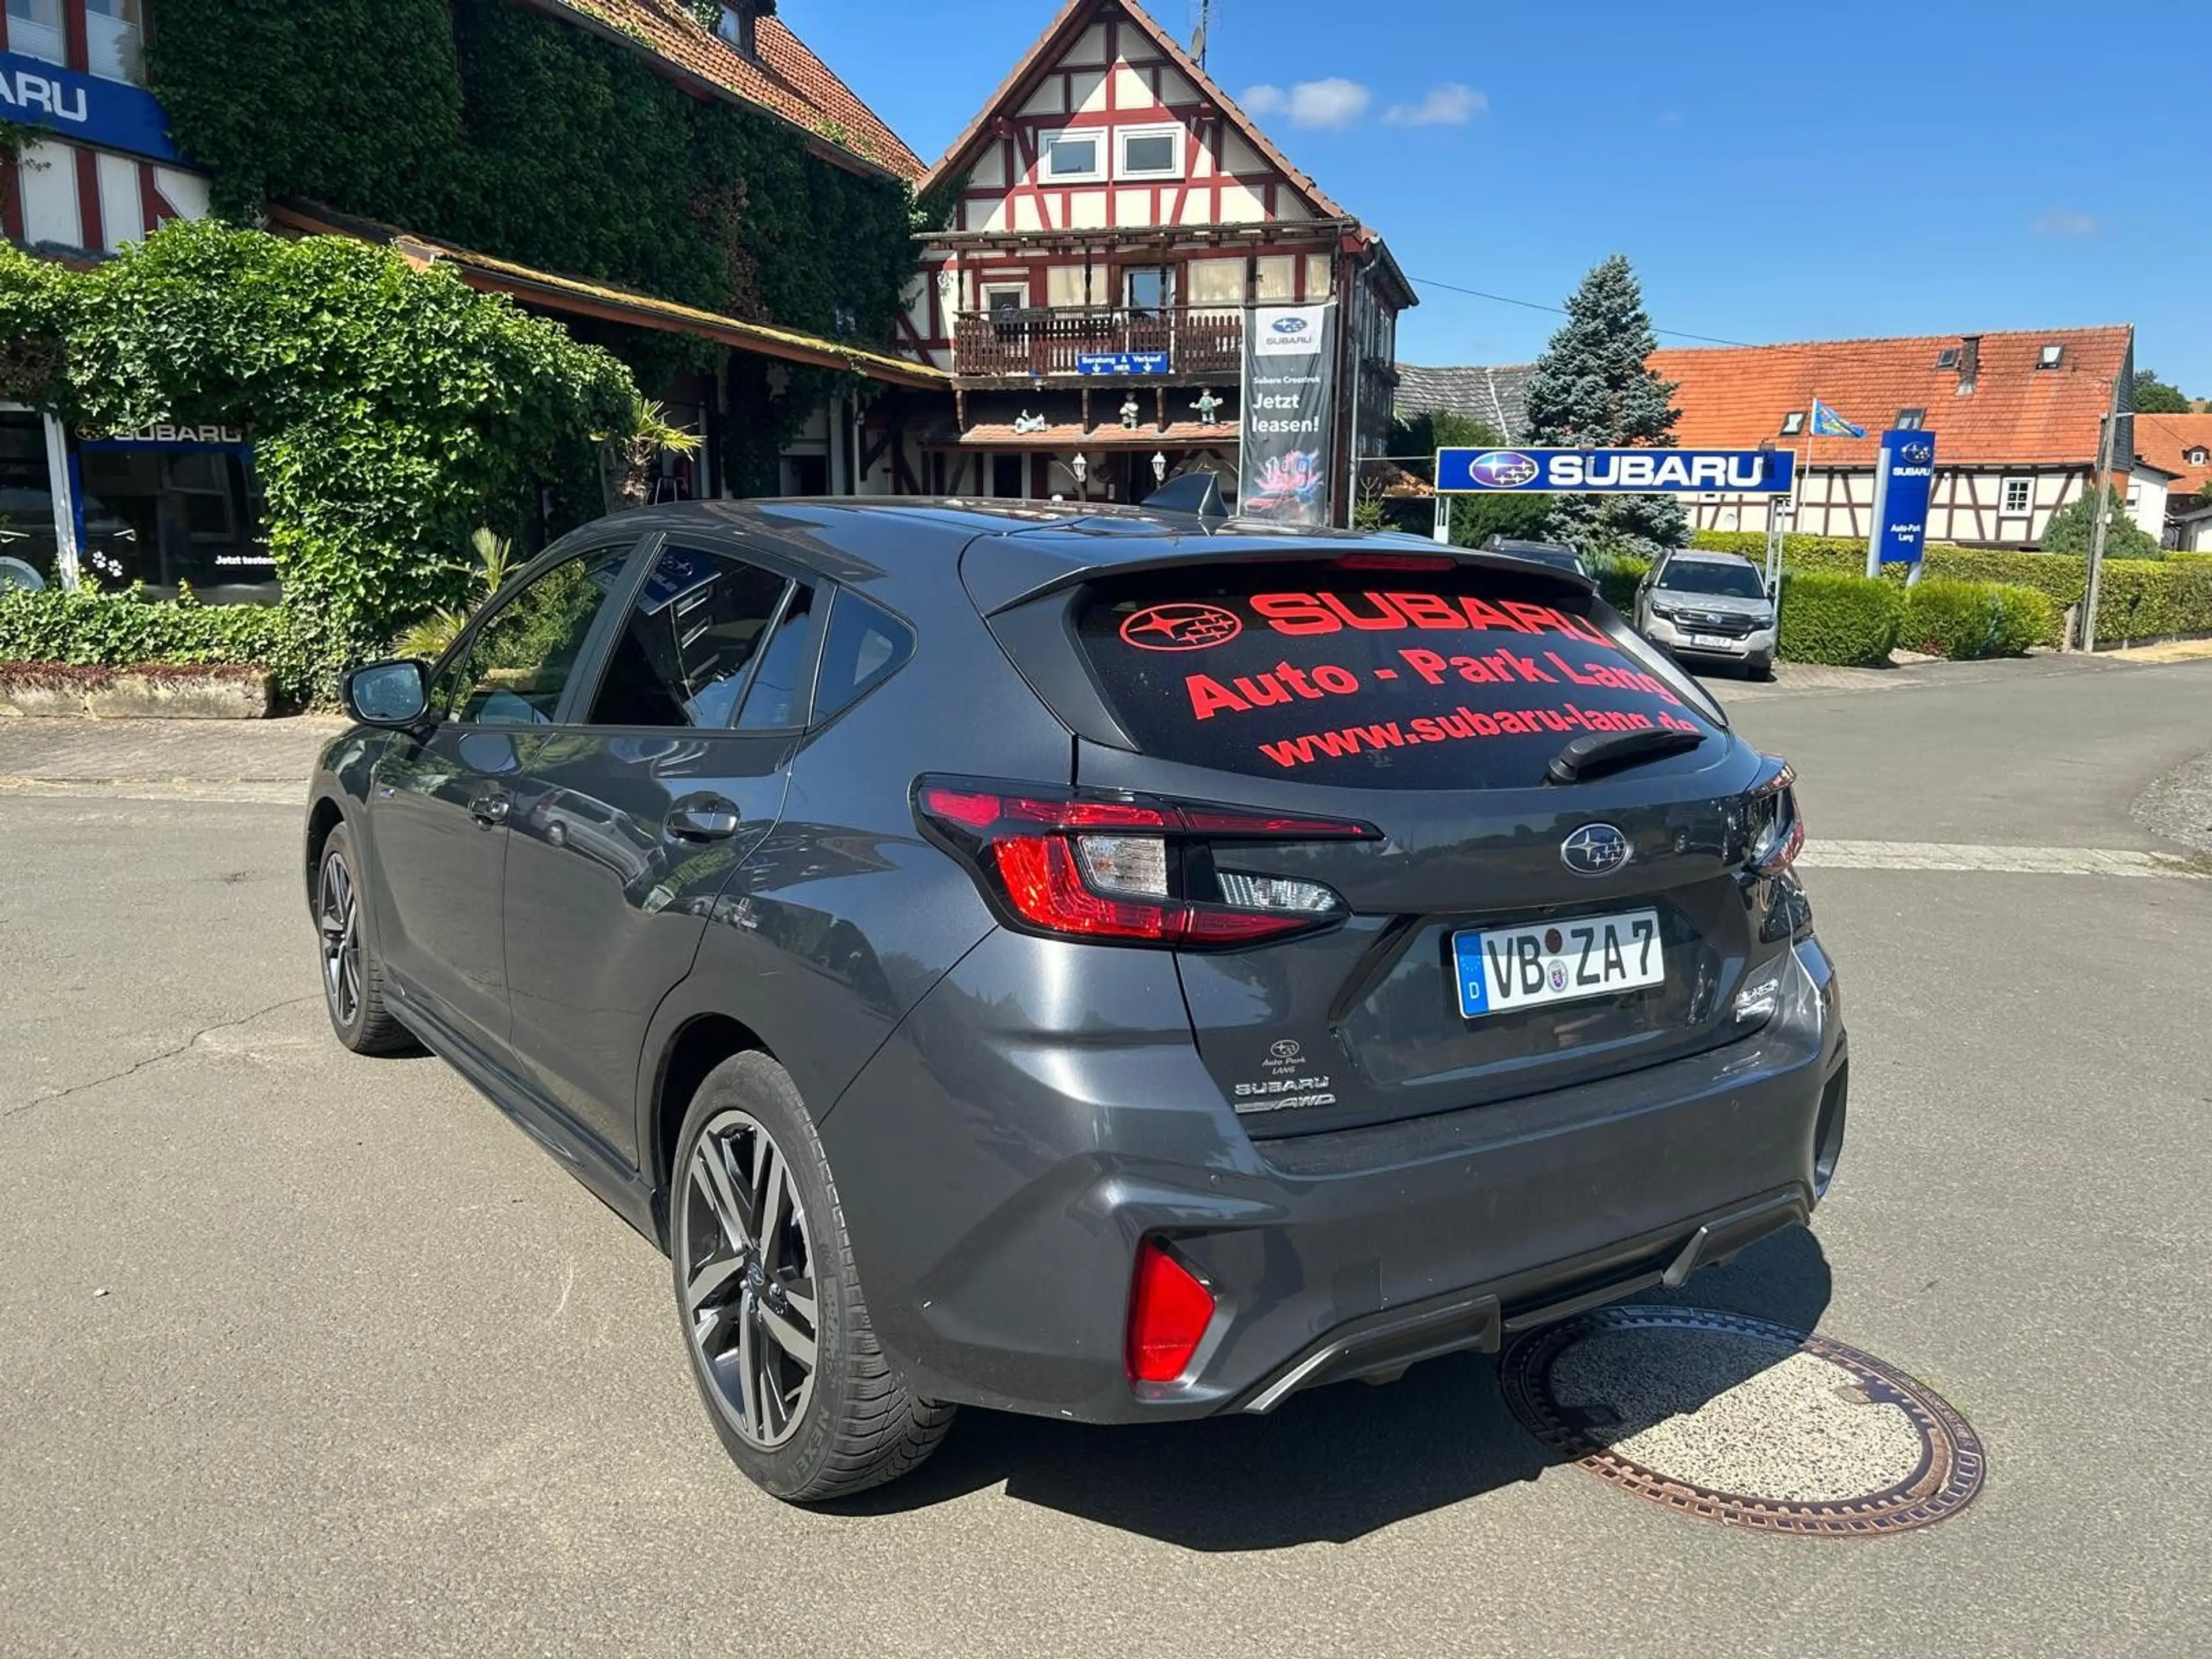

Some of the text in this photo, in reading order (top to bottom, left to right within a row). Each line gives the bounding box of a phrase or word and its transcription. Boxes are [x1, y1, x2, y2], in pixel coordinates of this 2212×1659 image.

[1266, 336, 1311, 344] SUBARU
[1253, 393, 1300, 408] Jetzt
[1252, 416, 1319, 432] leasen!
[1548, 456, 1763, 486] SUBARU
[1893, 467, 1931, 476] SUBARU
[1898, 533, 1914, 543] Lang
[215, 555, 241, 565] Jetzt
[1250, 592, 1618, 648] SUBARU
[1185, 661, 1359, 720] Auto
[1398, 648, 1559, 684] Park
[1544, 652, 1683, 707] Lang
[1487, 919, 1653, 998] VB ZA 7
[1469, 982, 1479, 999] D
[1262, 1056, 1306, 1067] Auto Park
[1272, 1066, 1295, 1075] LANG
[1235, 1075, 1330, 1095] SUBARU
